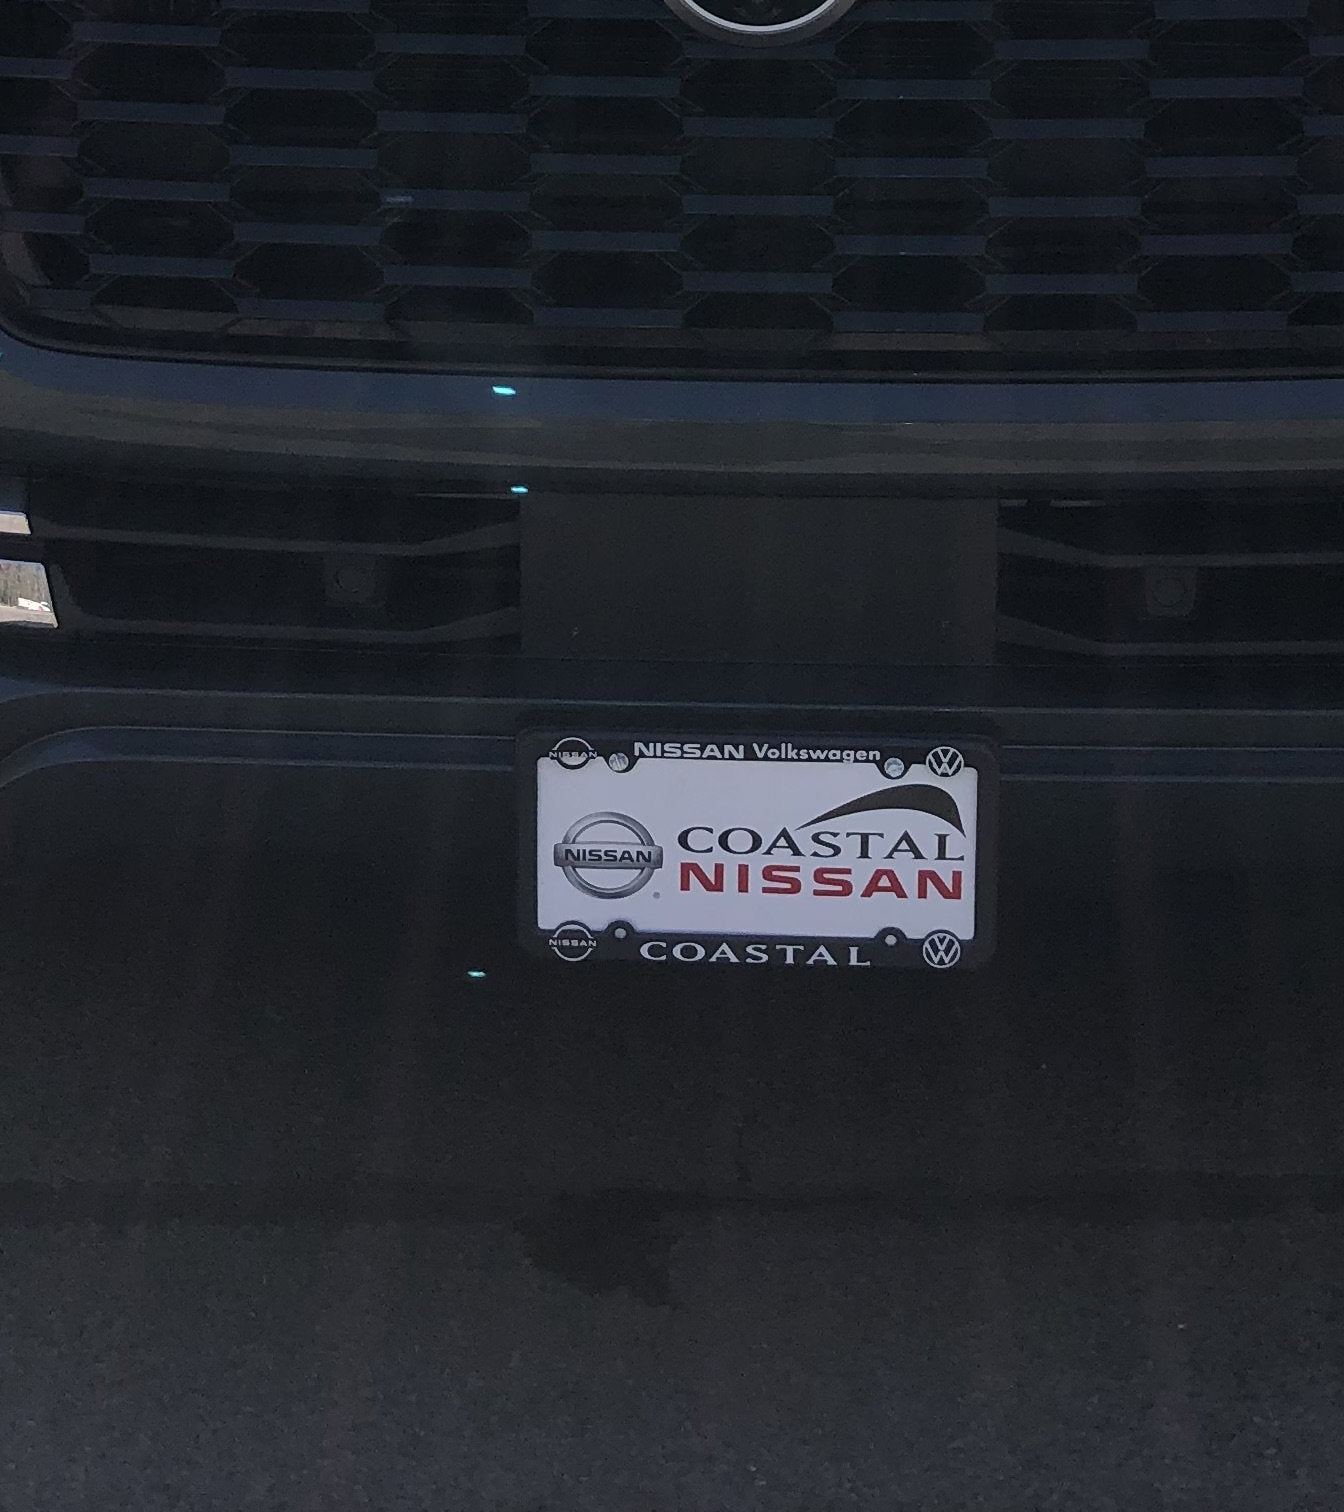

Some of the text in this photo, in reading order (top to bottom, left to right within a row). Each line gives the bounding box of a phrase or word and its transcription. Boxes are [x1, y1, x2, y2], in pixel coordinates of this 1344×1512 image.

[548, 750, 598, 759] NISSAN
[633, 741, 881, 764] NISSAN Volkswagen
[563, 846, 653, 864] NISSAN
[676, 826, 966, 861] COASTAL
[679, 862, 963, 900] NISSAN
[548, 938, 597, 948] NISSAN
[639, 941, 871, 967] COASTAL
